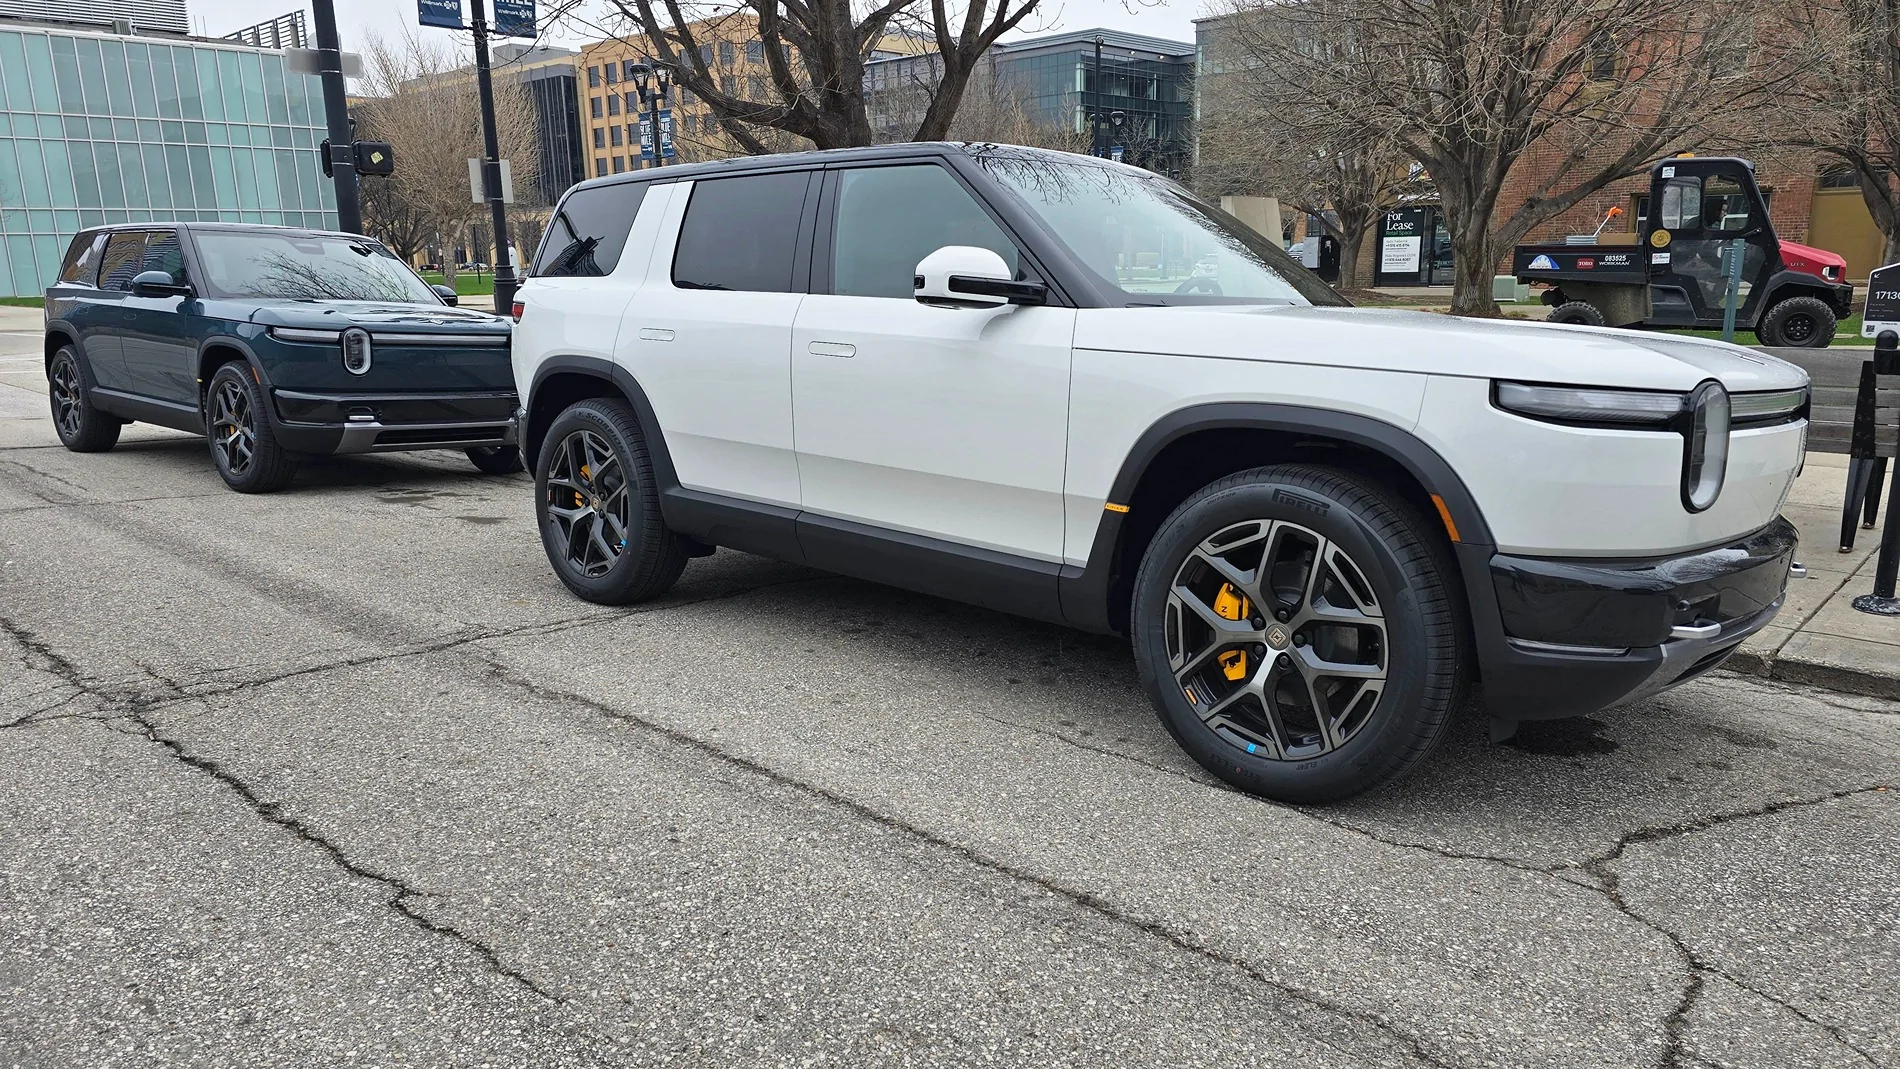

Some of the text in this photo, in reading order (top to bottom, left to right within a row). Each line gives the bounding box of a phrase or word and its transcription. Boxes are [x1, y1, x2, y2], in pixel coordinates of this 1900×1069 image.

[1386, 221, 1414, 231] Lease
[585, 412, 626, 454] SCORPION
[1271, 488, 1331, 518] PIRELLI
